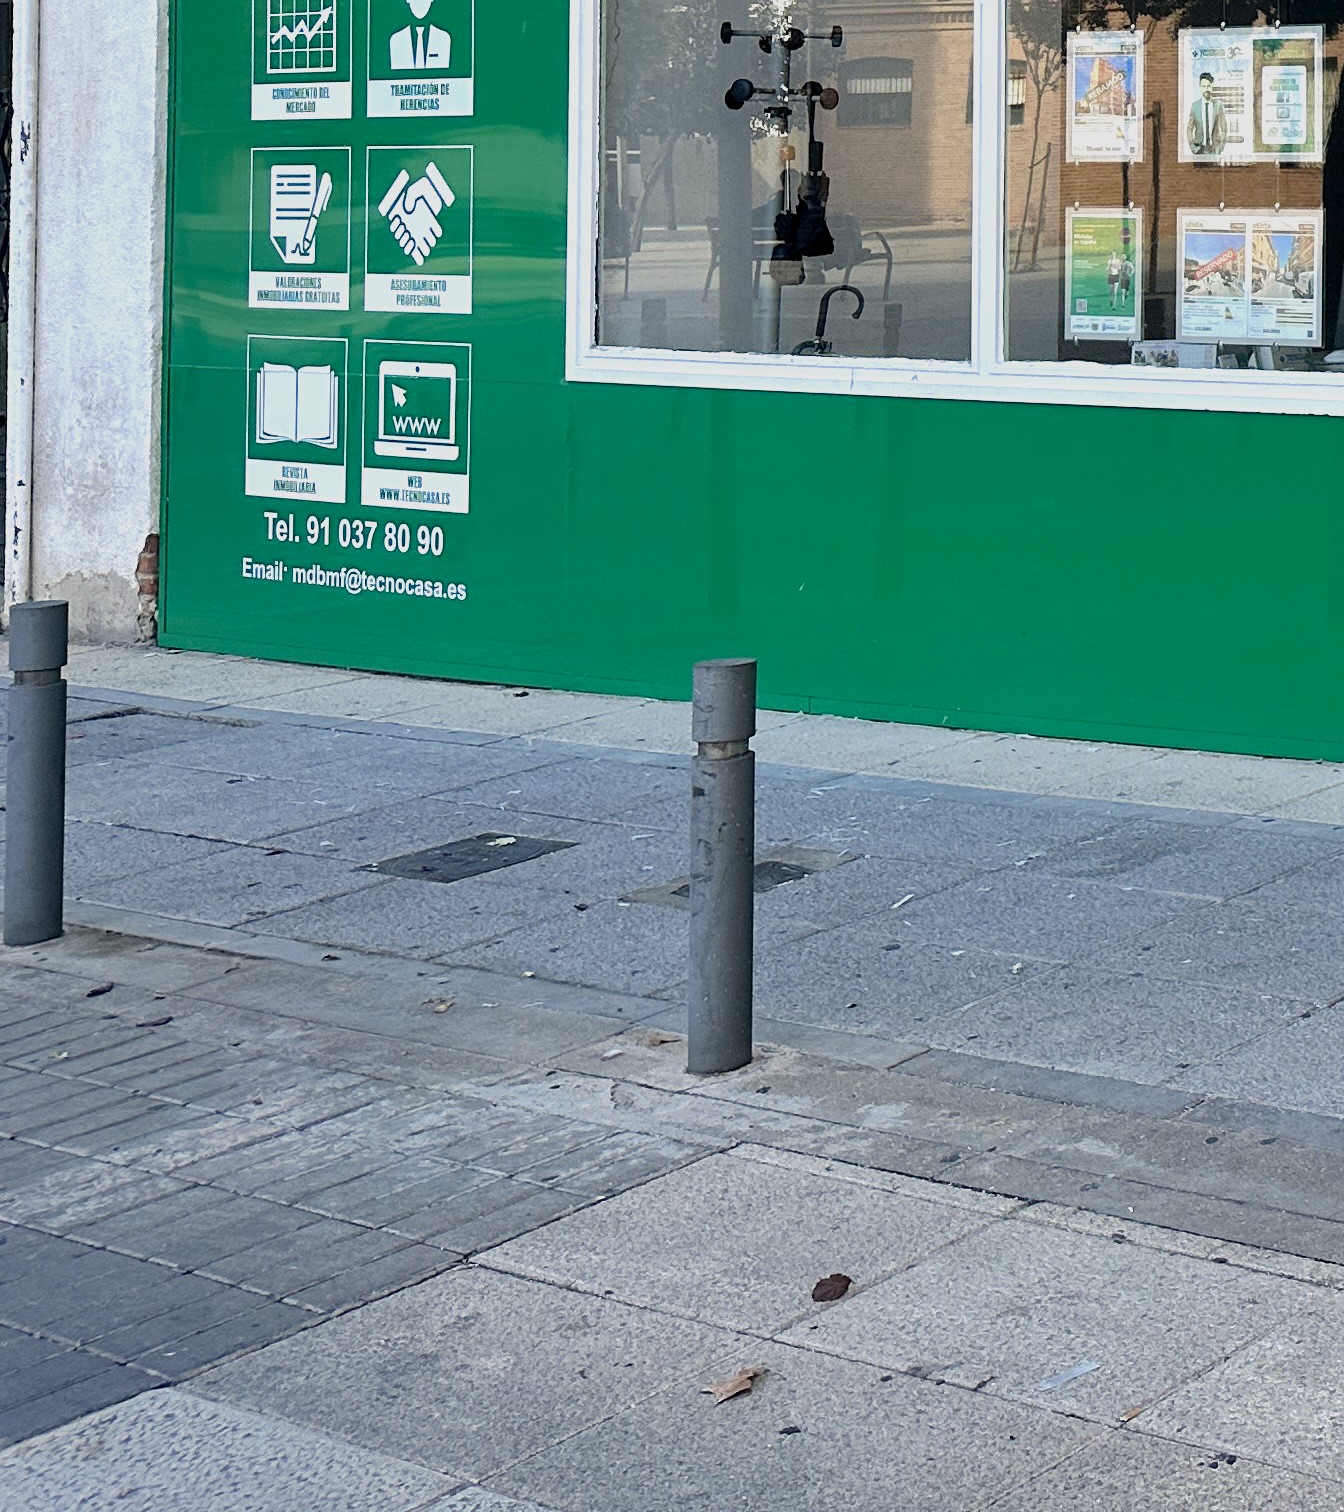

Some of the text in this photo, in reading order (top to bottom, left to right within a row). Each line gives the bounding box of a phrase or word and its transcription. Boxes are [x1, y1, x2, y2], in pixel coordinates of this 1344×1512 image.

[440, 83, 450, 96] DE
[1087, 71, 1124, 100] REBAJADO
[272, 87, 330, 100] CONOCIMIENTO DEL
[286, 101, 316, 113] MERCADO
[400, 98, 440, 111] HERENCIAS
[276, 276, 322, 289] VALORACIONES
[391, 278, 447, 292] ASESORAMIENTO
[257, 290, 340, 304] INMOBILIARIAS GRATUITAS
[396, 294, 441, 307] PROFESIONAL
[392, 415, 441, 435] WWW
[281, 465, 308, 479] REVISTA
[273, 479, 316, 494] INMOBILIARIA
[407, 475, 422, 488] WEB
[379, 488, 450, 505] WWW.TECNOCASA.ES
[263, 511, 444, 556] Tel. 91 037 80 90
[292, 564, 467, 601] mdbmf@tecnocasa.es
